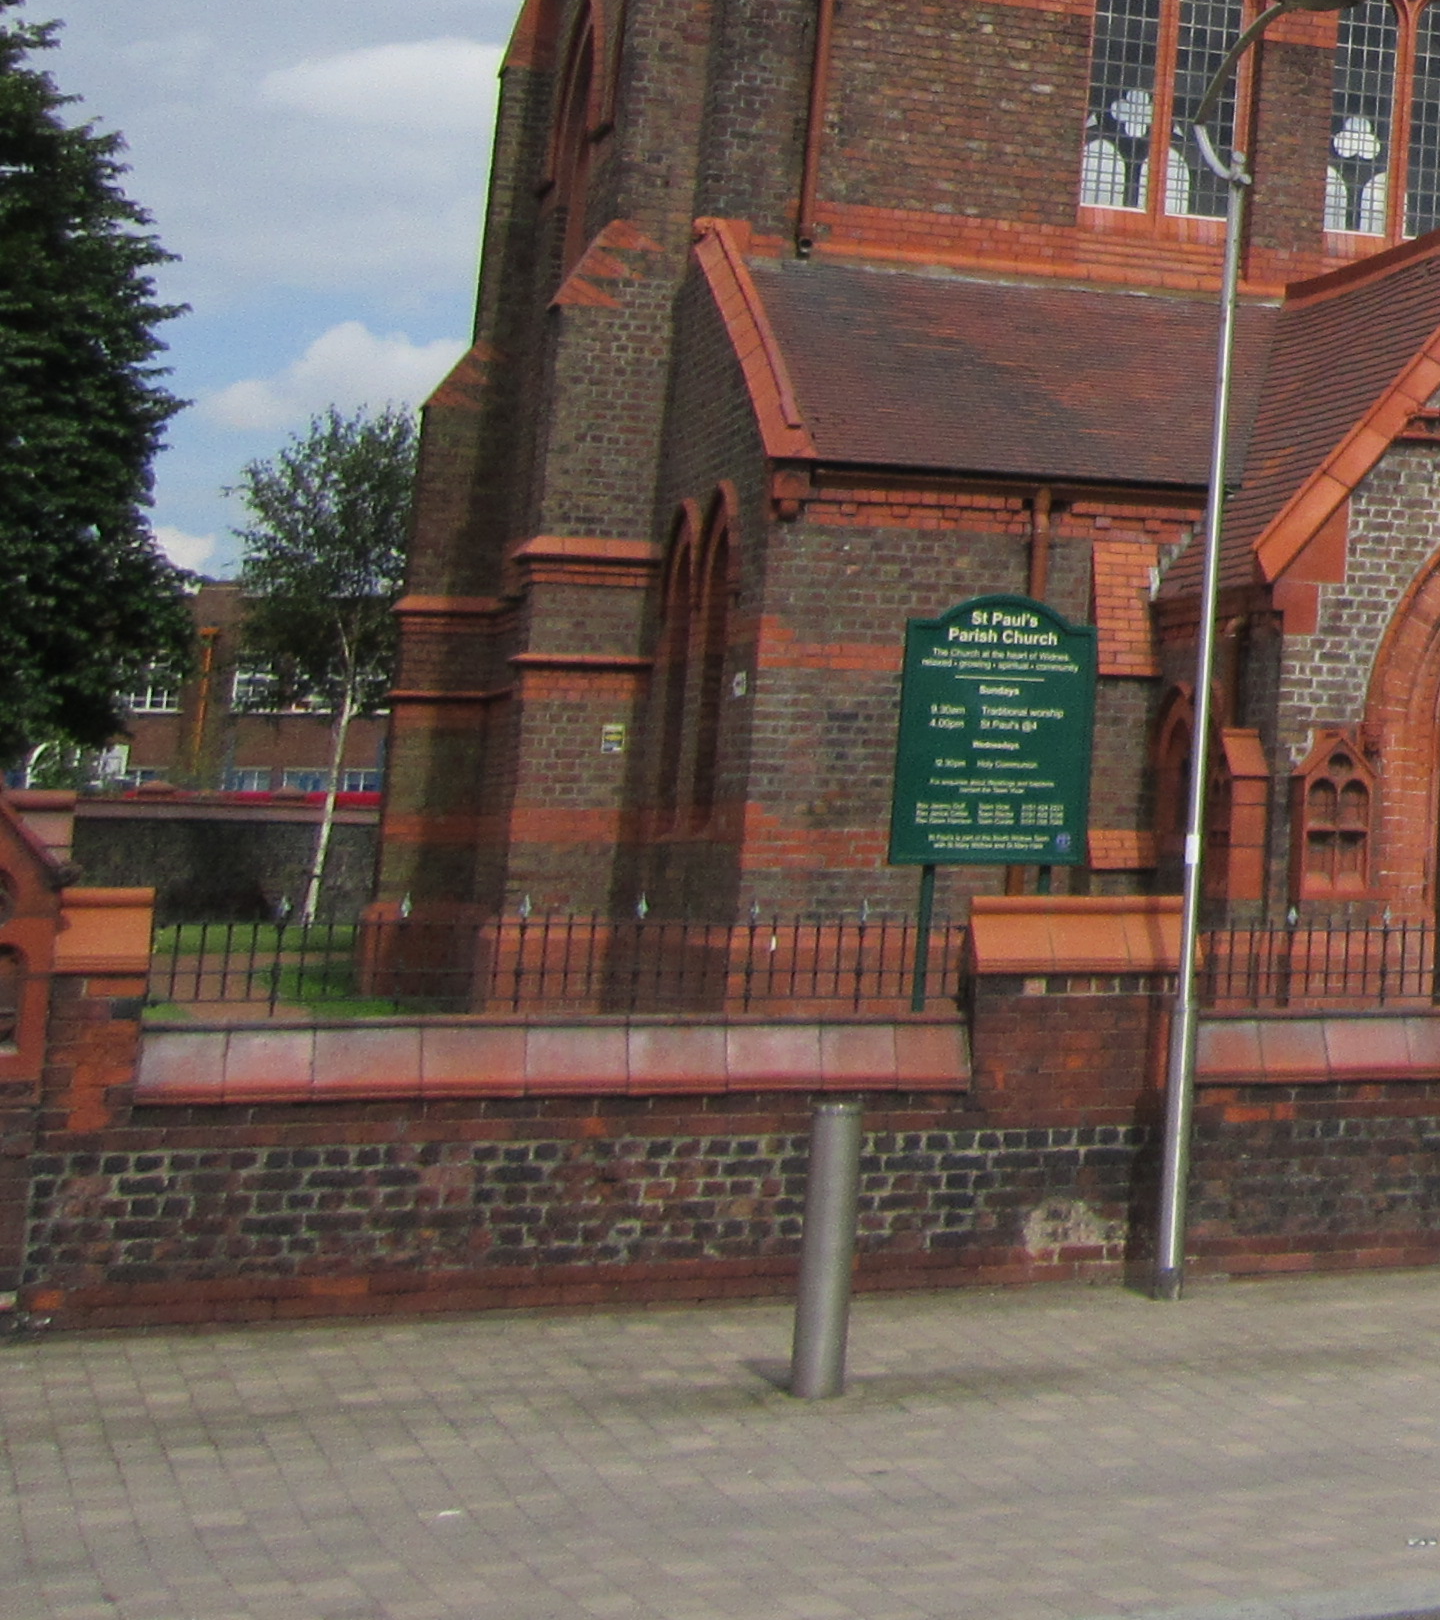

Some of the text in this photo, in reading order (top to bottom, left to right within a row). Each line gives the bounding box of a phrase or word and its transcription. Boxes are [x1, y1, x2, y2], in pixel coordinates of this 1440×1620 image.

[972, 611, 1038, 628] St Paul's
[948, 627, 1058, 645] Parish Church
[934, 647, 948, 656] The
[950, 649, 980, 657] Church
[1007, 651, 1027, 659] heart
[1029, 652, 1037, 660] of
[1039, 653, 1069, 661] Widnes
[959, 661, 991, 670] growing
[1036, 664, 1078, 673] community
[979, 685, 1019, 697] Sundays
[982, 705, 1027, 716] Traditional
[1030, 708, 1063, 719] worship
[980, 719, 990, 729] St
[977, 760, 993, 768] Holy
